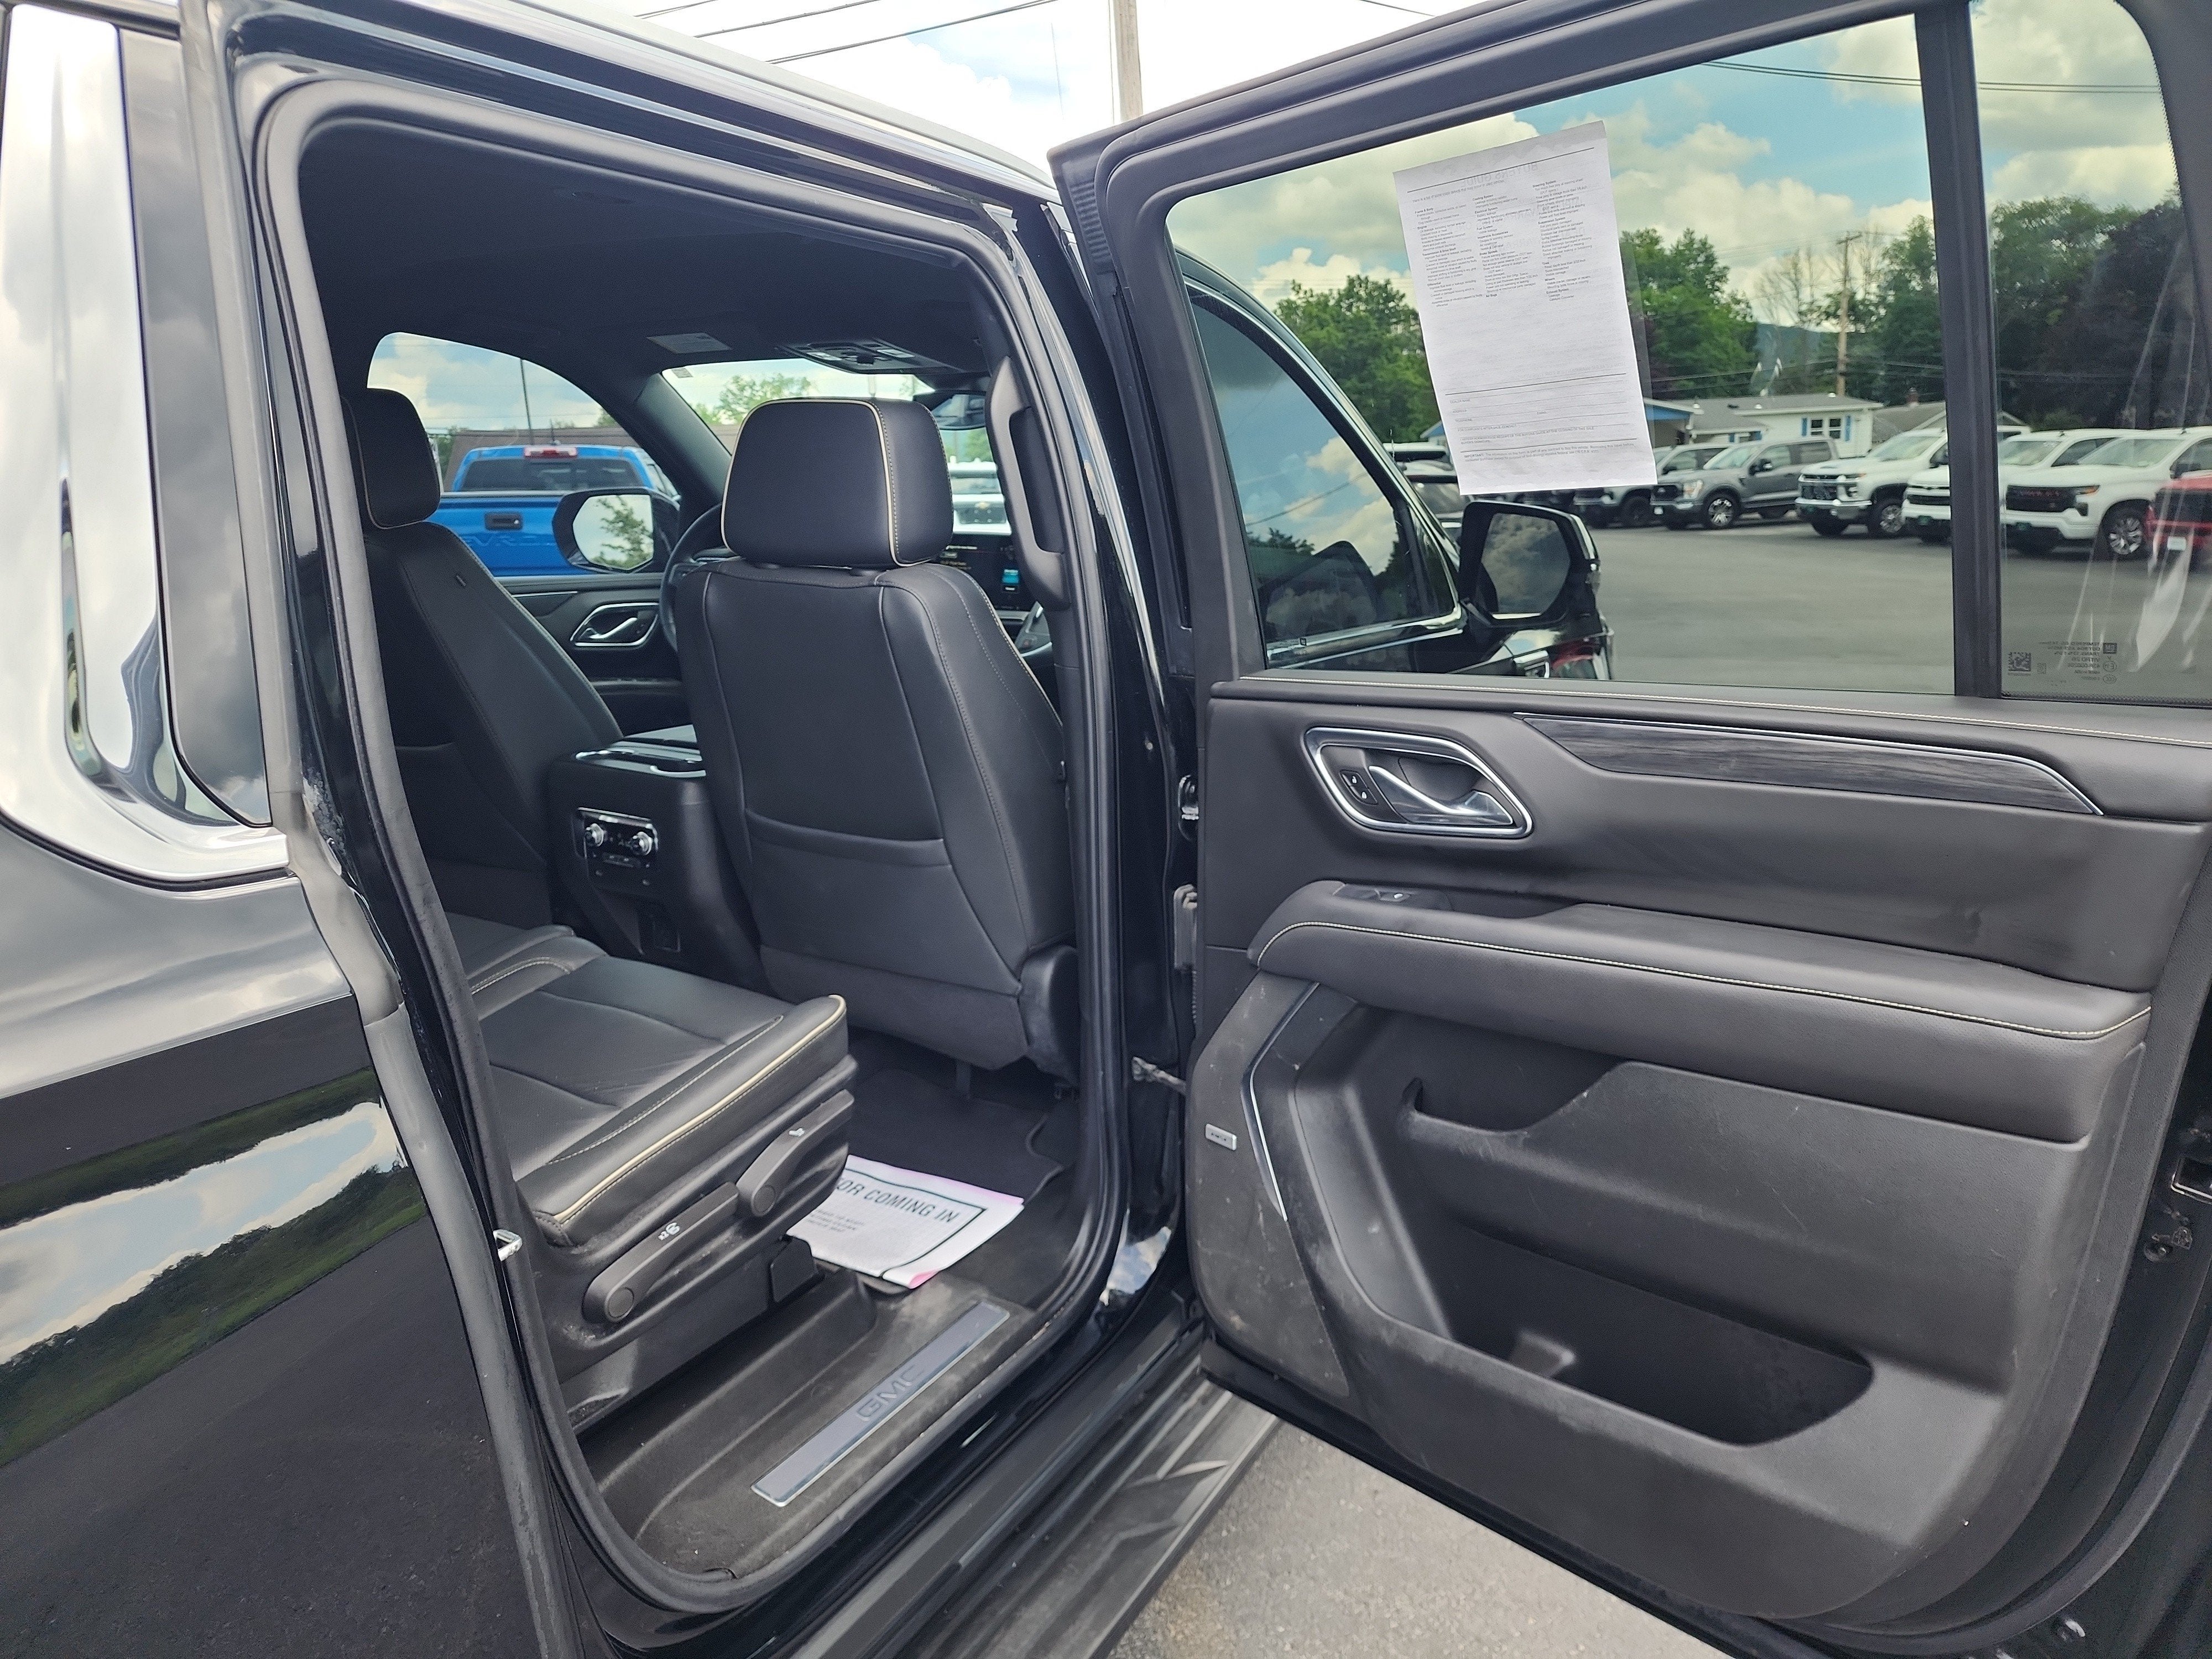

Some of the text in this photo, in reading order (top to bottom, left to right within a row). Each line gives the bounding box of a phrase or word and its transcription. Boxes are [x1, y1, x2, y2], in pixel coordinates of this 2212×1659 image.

[836, 1177, 961, 1223] OR COMING IN
[855, 1364, 925, 1422] GMC
